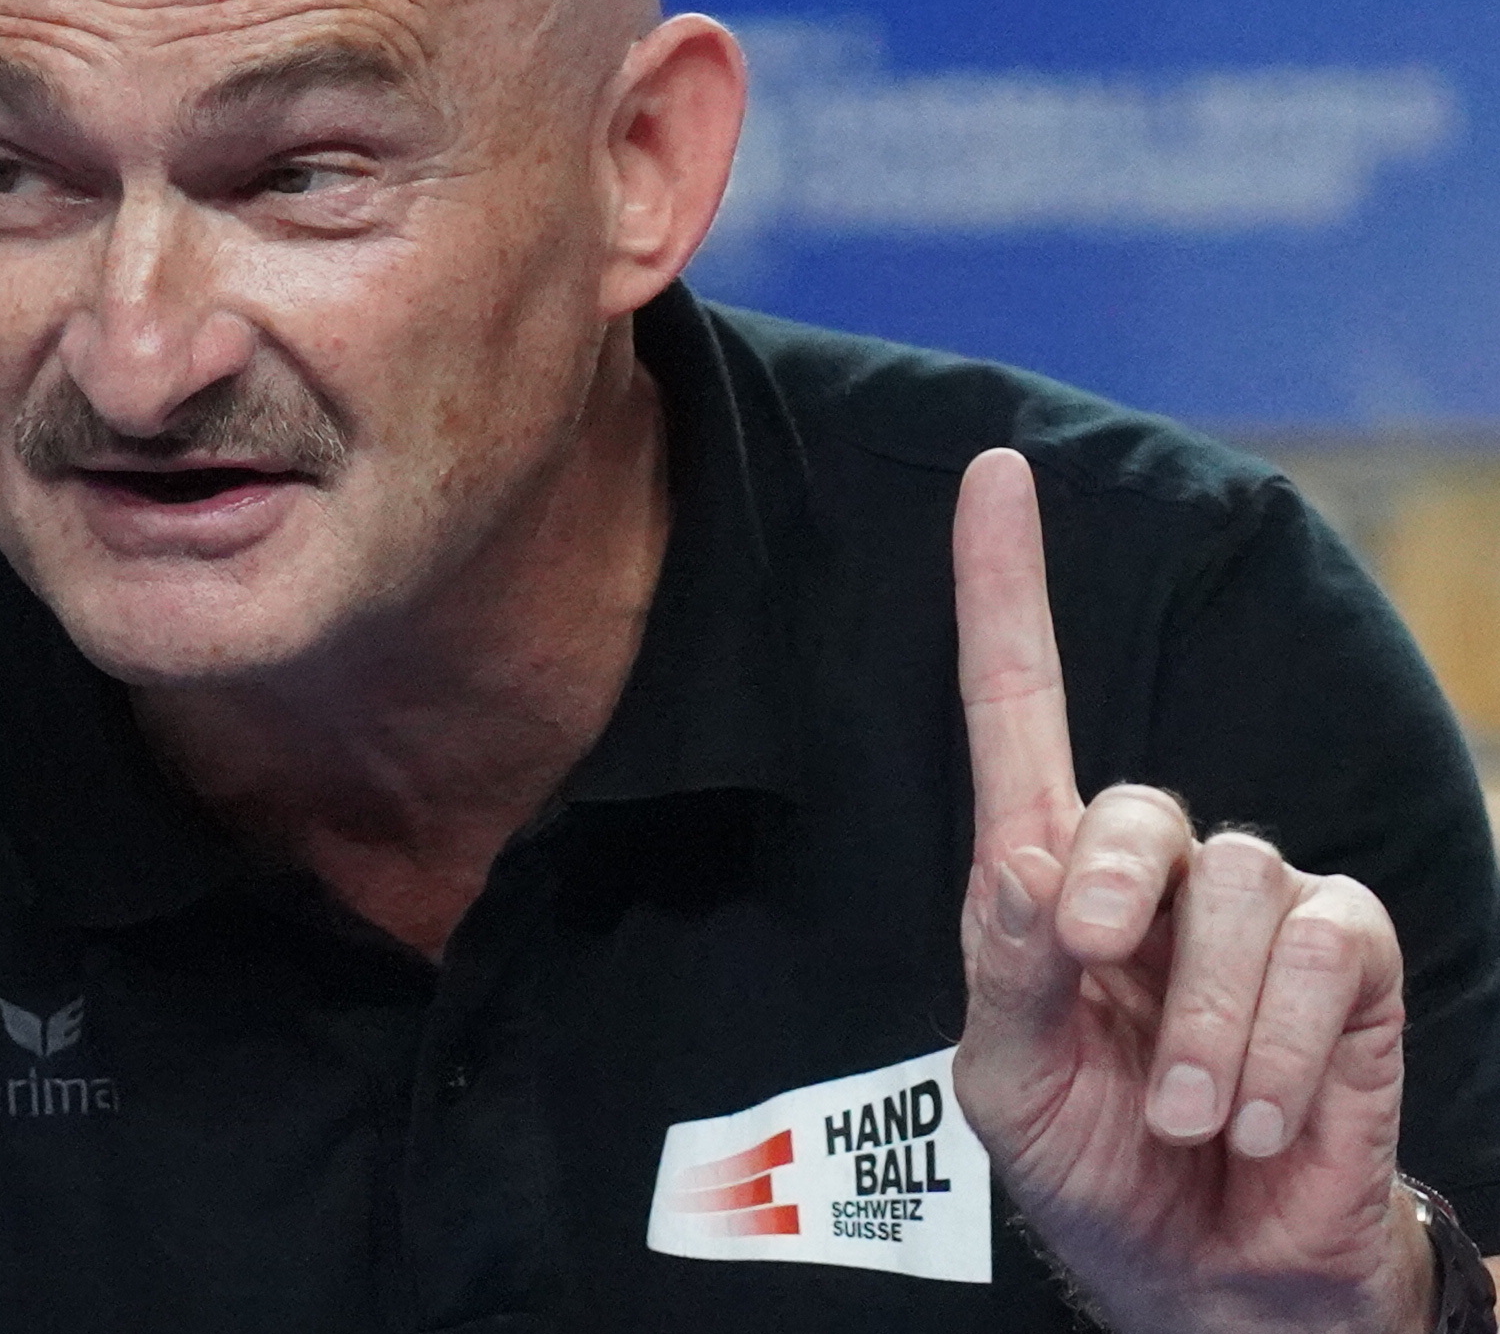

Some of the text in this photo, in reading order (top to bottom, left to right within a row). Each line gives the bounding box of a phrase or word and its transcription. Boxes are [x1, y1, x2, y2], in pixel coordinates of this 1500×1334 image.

[824, 1078, 944, 1156] HAND
[855, 1140, 951, 1197] BALL
[831, 1199, 924, 1222] SCHWEIZ
[832, 1221, 904, 1242] SUISSE
